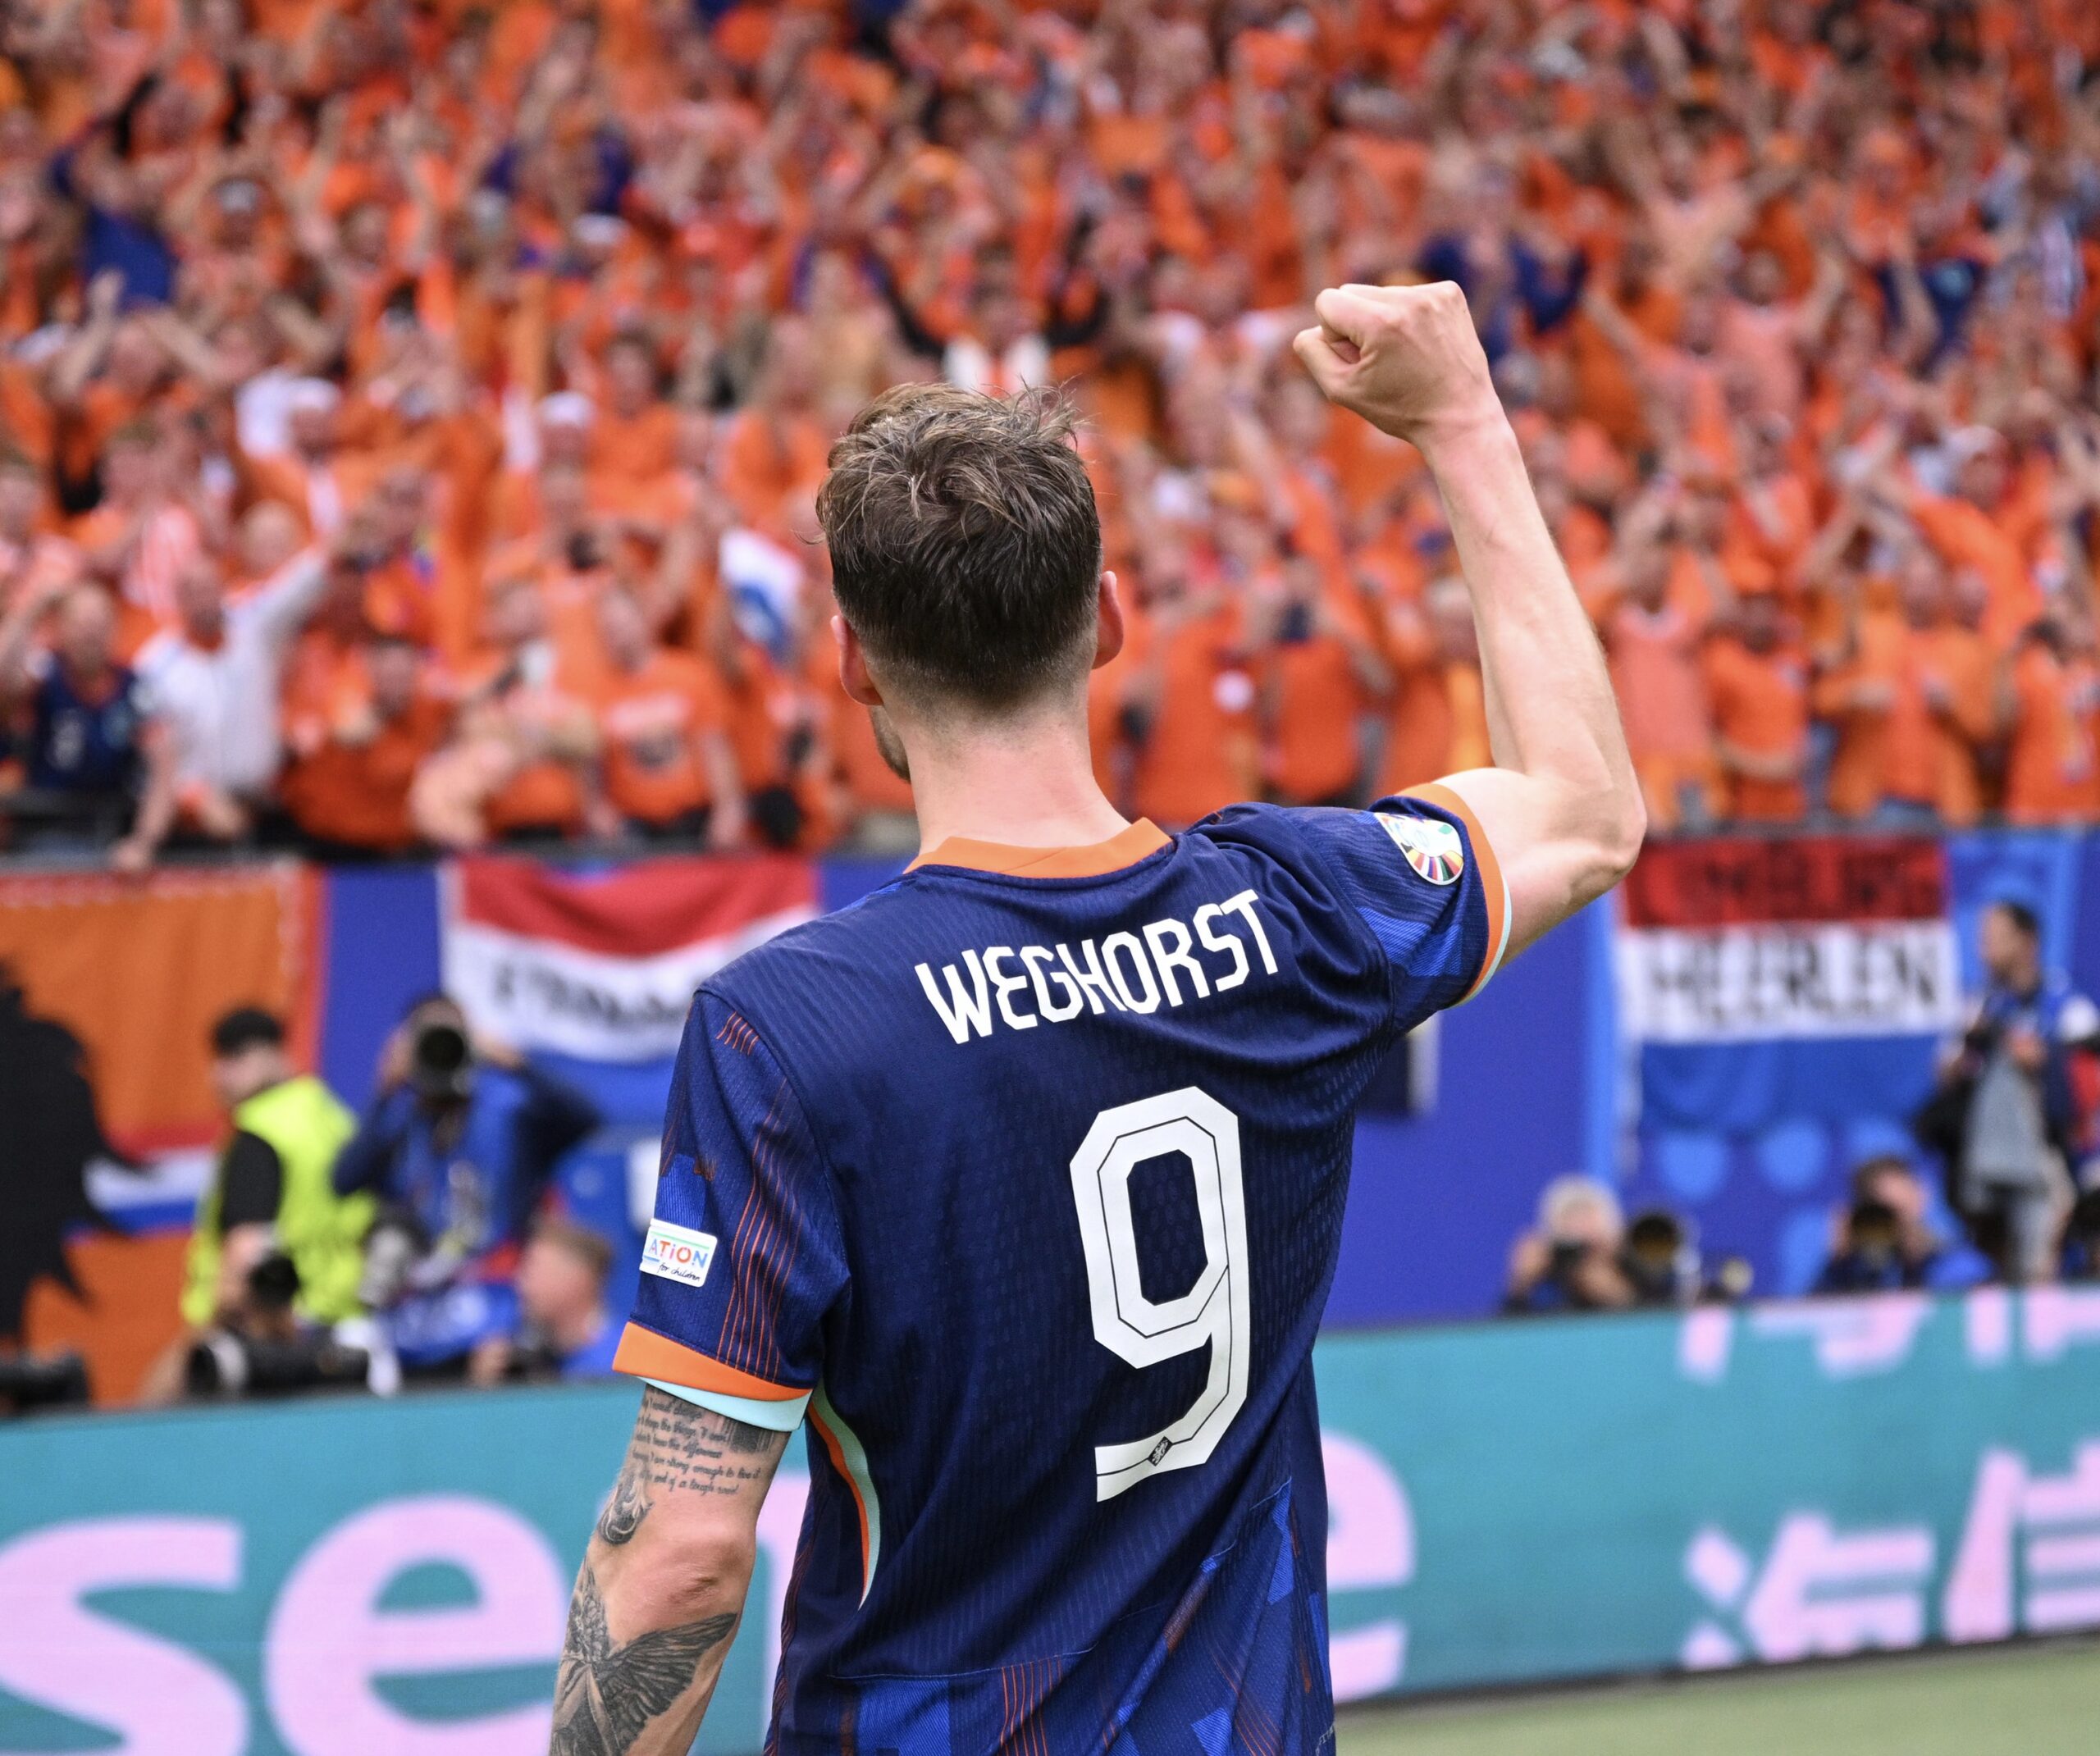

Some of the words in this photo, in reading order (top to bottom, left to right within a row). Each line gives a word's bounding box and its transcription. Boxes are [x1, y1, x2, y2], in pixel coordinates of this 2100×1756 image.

[915, 888, 1279, 1045] WEGHORST
[657, 1262, 669, 1274] for
[670, 1267, 701, 1282] children
[1069, 1085, 1251, 1503] 9
